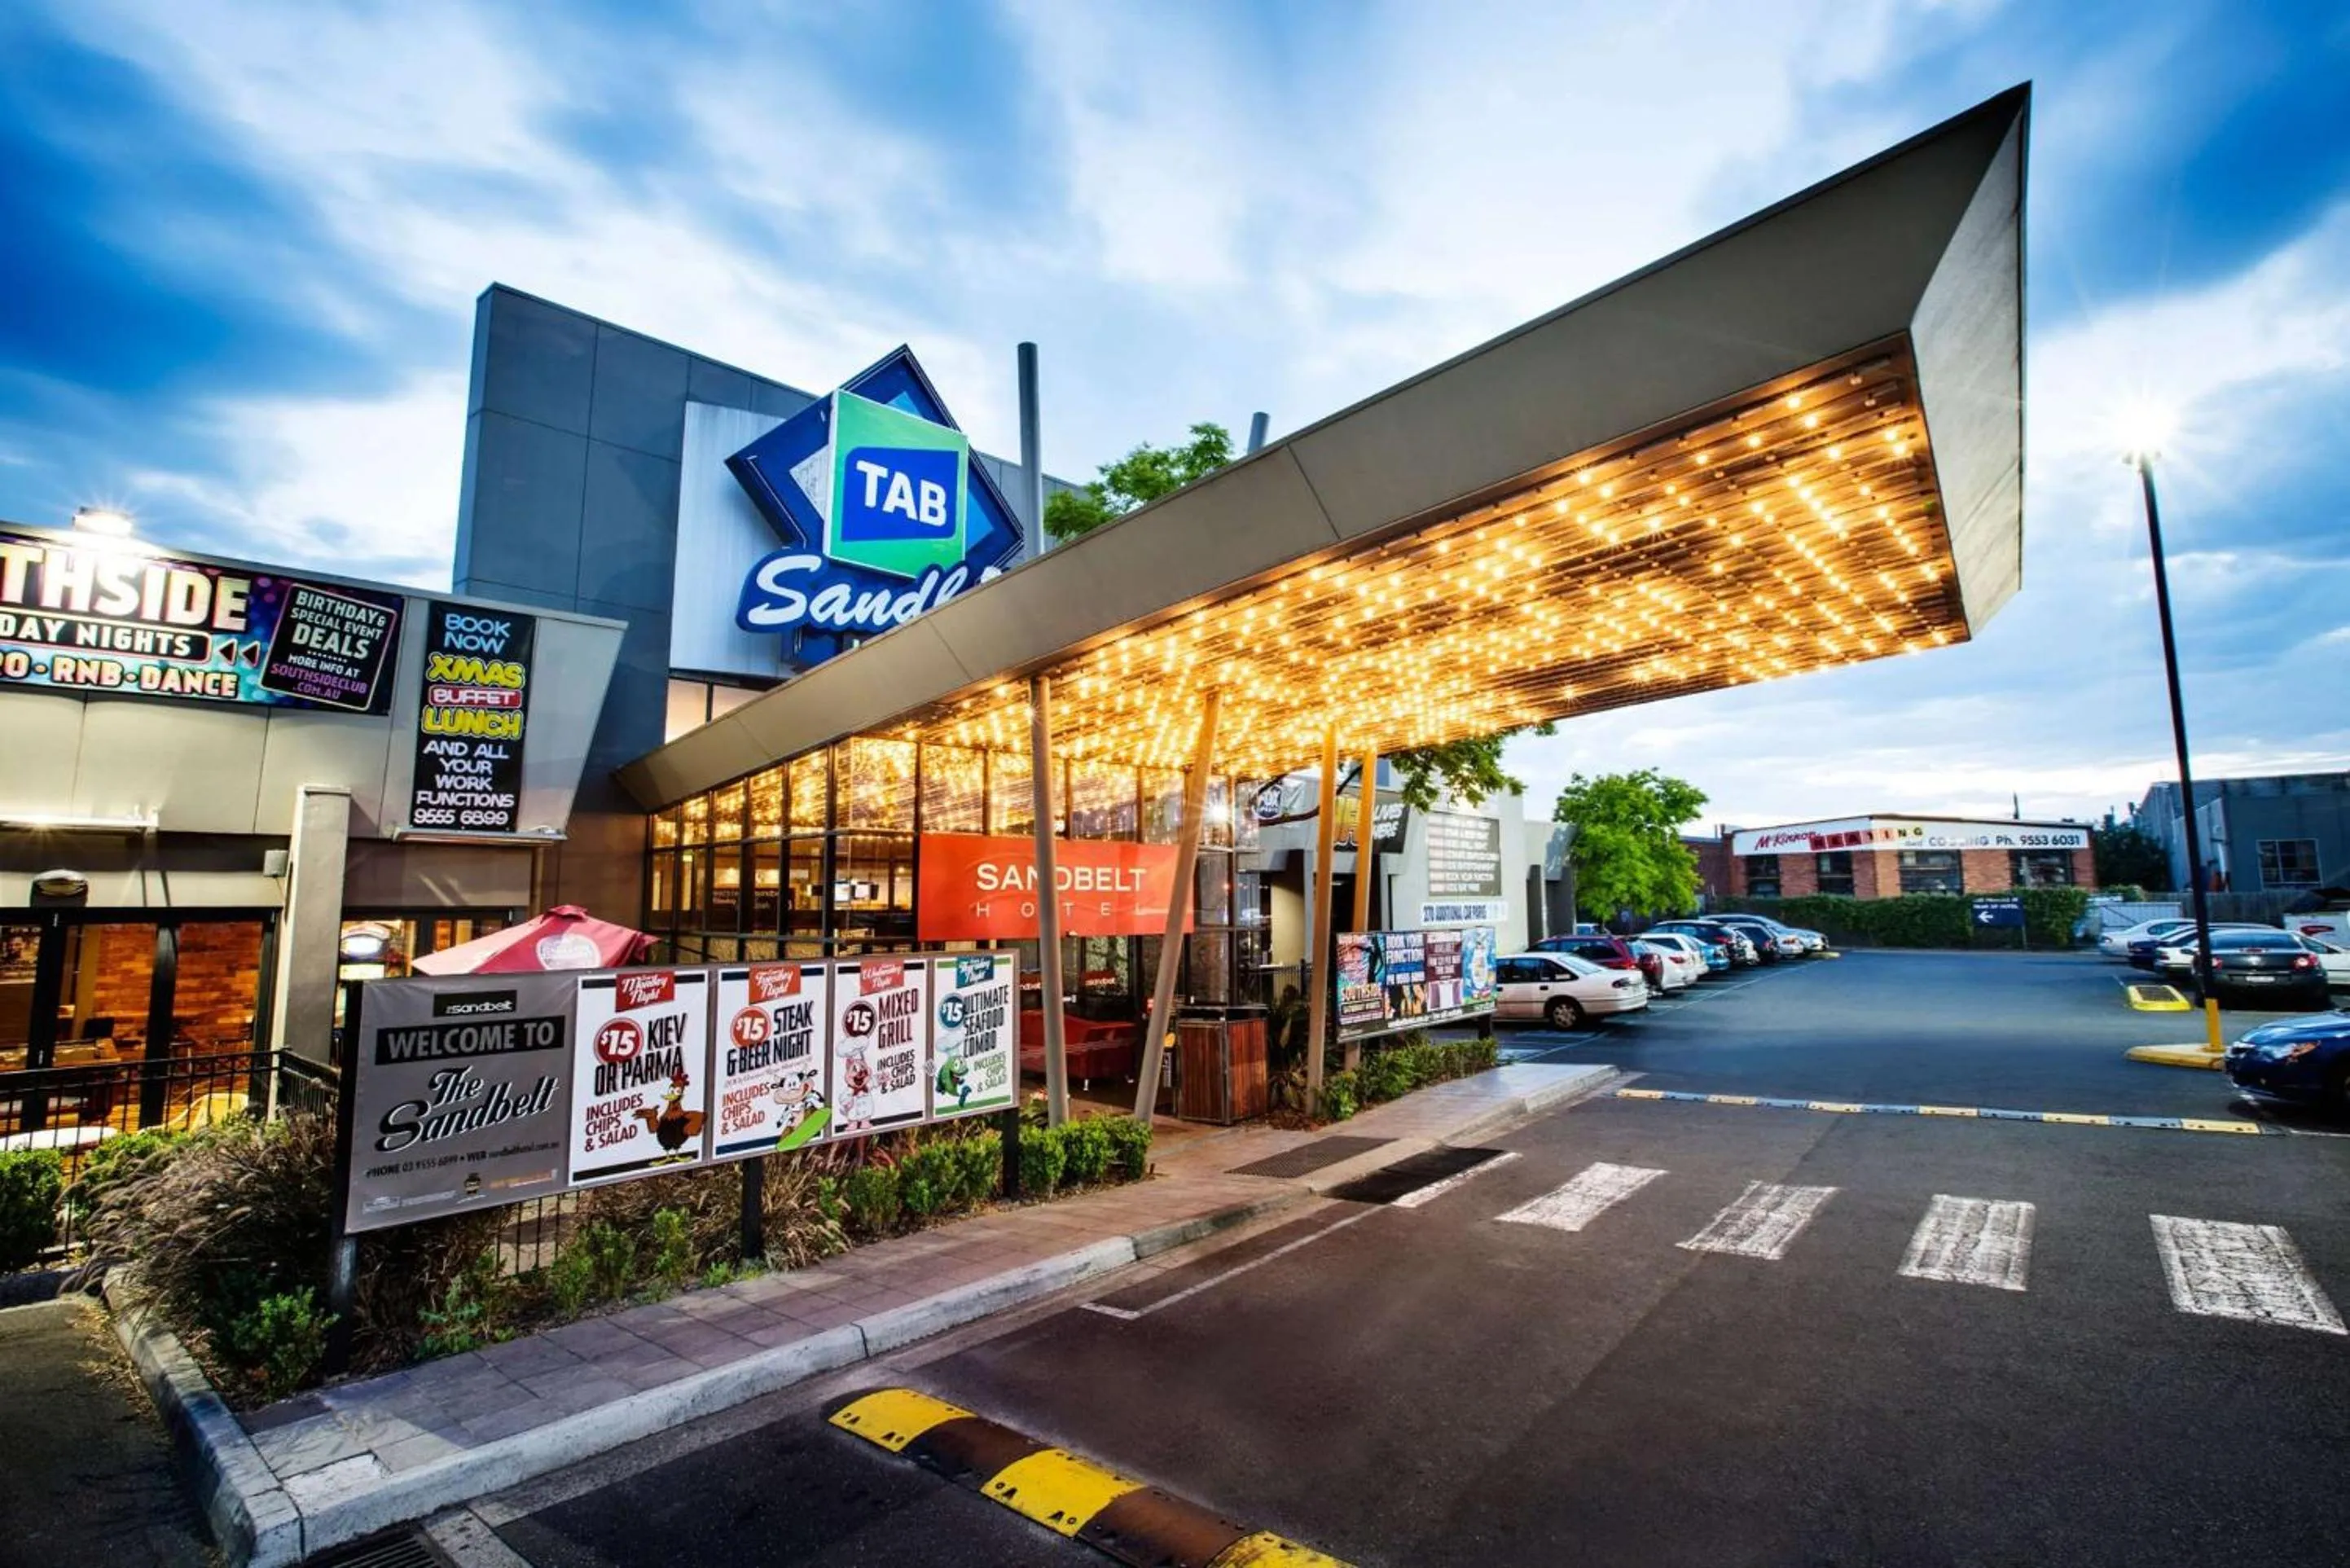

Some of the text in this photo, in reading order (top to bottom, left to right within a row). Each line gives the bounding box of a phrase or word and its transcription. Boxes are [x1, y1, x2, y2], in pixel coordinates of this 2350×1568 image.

[856, 459, 947, 527] TAB
[0, 542, 251, 631] THSIDE
[748, 554, 1003, 627] Sand
[296, 591, 378, 625] BIRTHDAY
[291, 607, 384, 640] SPECIAL EVENT
[445, 613, 512, 638] BOOK
[75, 624, 191, 657] NIGHTS
[292, 622, 370, 660] DEALS
[443, 632, 506, 654] NOW
[51, 656, 123, 688] RNB
[138, 664, 239, 698] DANCE
[270, 663, 367, 694] SOUTHSIDECLUB
[288, 653, 362, 679] MORE INFO AT
[427, 654, 524, 689] XMAS
[433, 688, 516, 705] BUFFET
[422, 706, 523, 739] LUNCH
[423, 740, 510, 759] AND ALL
[439, 758, 493, 775] YOUR
[435, 775, 493, 791] WORK
[416, 791, 514, 808] FUNCTIONS
[413, 807, 509, 825] 9555 6899
[2019, 835, 2051, 846] 9553
[2052, 835, 2080, 846] 6031
[847, 988, 918, 1032] $15 MIXED
[964, 984, 1009, 1015] ULTIMATE
[600, 1012, 687, 1056] $15 KIEV
[736, 1000, 814, 1041] $15 STEAK
[878, 1017, 912, 1049] GRILL
[964, 1007, 1004, 1037] SEAFOOD
[387, 1021, 555, 1059] WELCOME TO
[738, 1040, 771, 1074] BEER
[773, 1028, 814, 1064] NIGHT
[963, 1030, 997, 1058] COMBO
[594, 1061, 617, 1096] OR
[622, 1046, 685, 1090] PARMA
[876, 1049, 916, 1071] INCLUDES
[891, 1062, 915, 1078] CHIPS
[428, 1065, 484, 1109] The
[722, 1082, 771, 1108] INCLUDES
[880, 1074, 916, 1094] & SALAD
[375, 1076, 561, 1153] Sandbelt
[586, 1093, 644, 1122] INCLUDES
[721, 1110, 766, 1135] & SALAD
[722, 1100, 751, 1121] CHIPS
[584, 1124, 638, 1152] & SALAD
[586, 1113, 622, 1136] CHIPS
